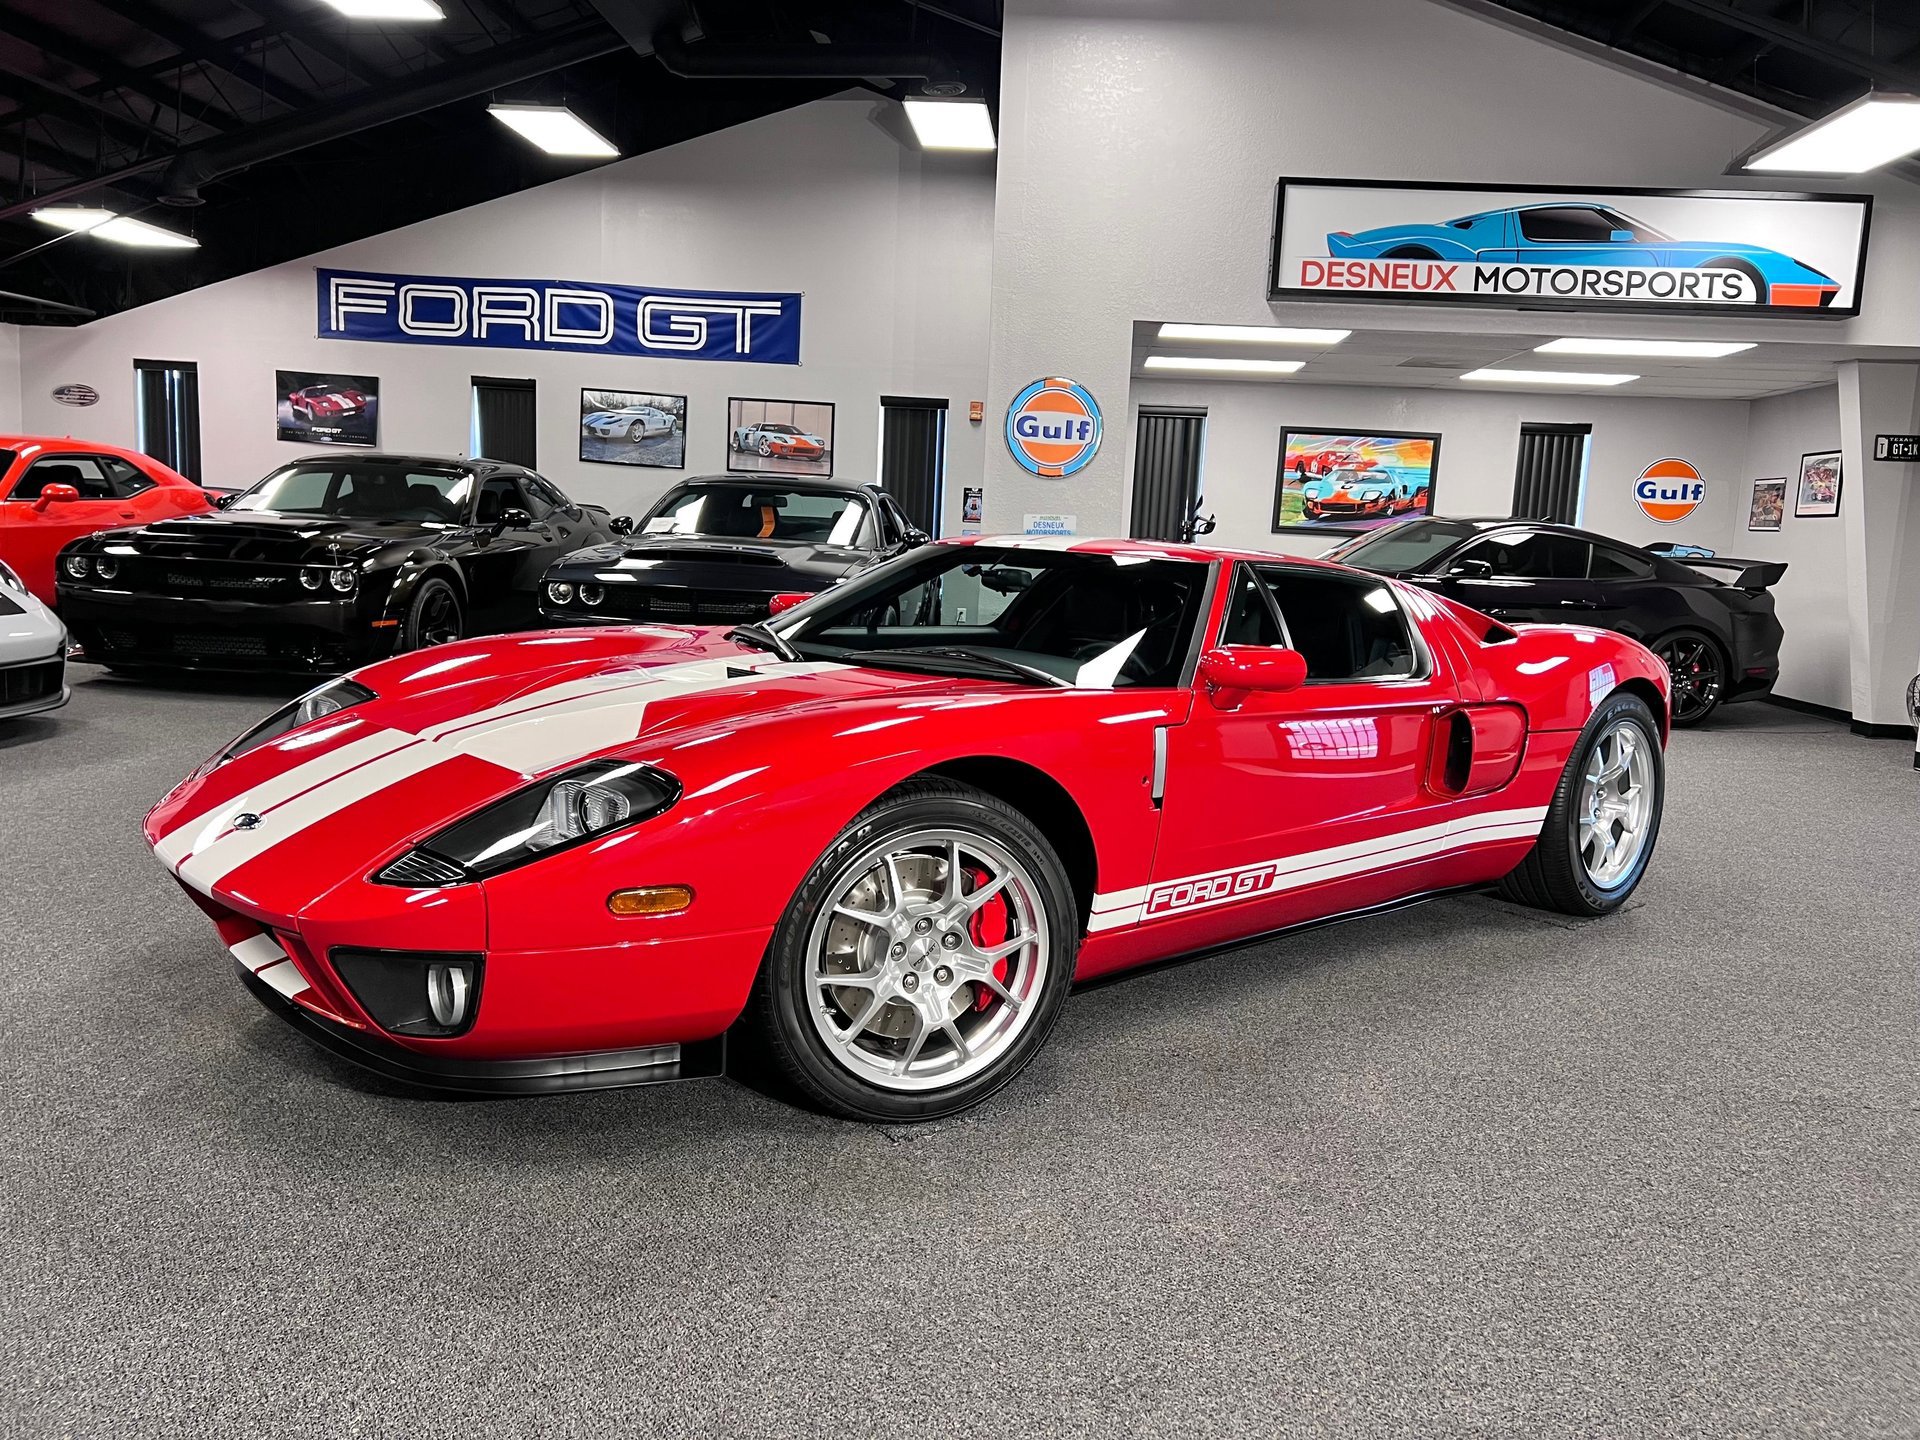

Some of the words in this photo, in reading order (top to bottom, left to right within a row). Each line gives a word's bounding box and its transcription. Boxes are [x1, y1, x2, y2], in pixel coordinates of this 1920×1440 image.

[1301, 260, 1459, 291] DESNEUX
[1473, 266, 1743, 299] MOTORSPORTS
[330, 277, 613, 346] FORD
[636, 295, 782, 354] GT
[1016, 415, 1090, 440] Gulf
[1637, 481, 1704, 500] Gulf
[1033, 521, 1065, 529] DESNEUX
[1149, 875, 1232, 912] FORD
[1233, 866, 1275, 893] GT
